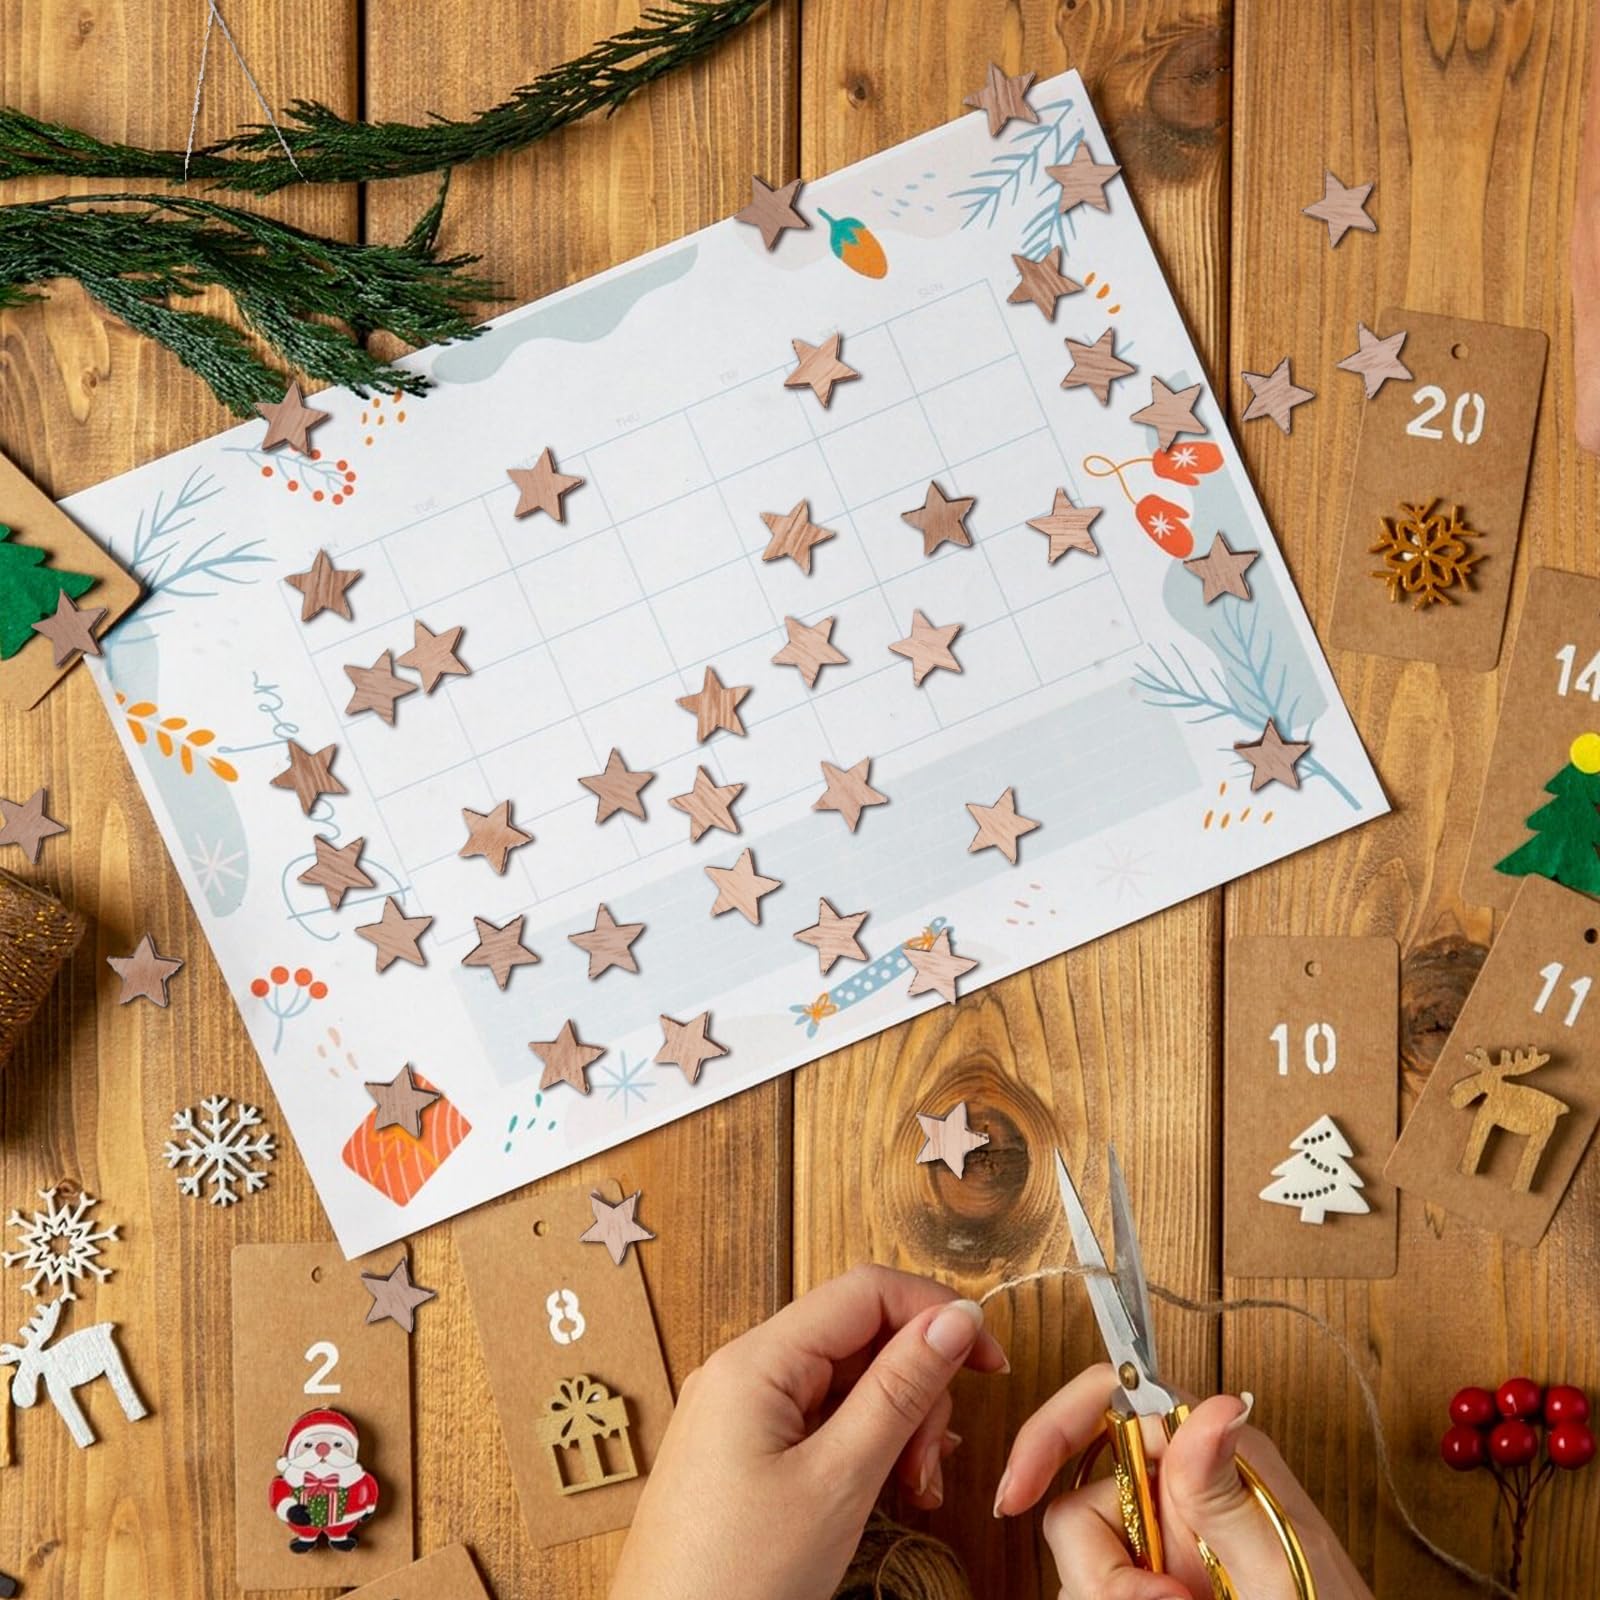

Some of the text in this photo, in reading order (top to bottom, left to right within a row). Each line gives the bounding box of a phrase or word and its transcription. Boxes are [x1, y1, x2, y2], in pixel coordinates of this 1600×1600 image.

[1406, 384, 1487, 446] 20
[1555, 644, 1600, 703] 14
[1533, 961, 1593, 1028] 11
[1268, 1021, 1338, 1077] 10
[546, 1288, 587, 1346] 8
[303, 1341, 342, 1395] 2
